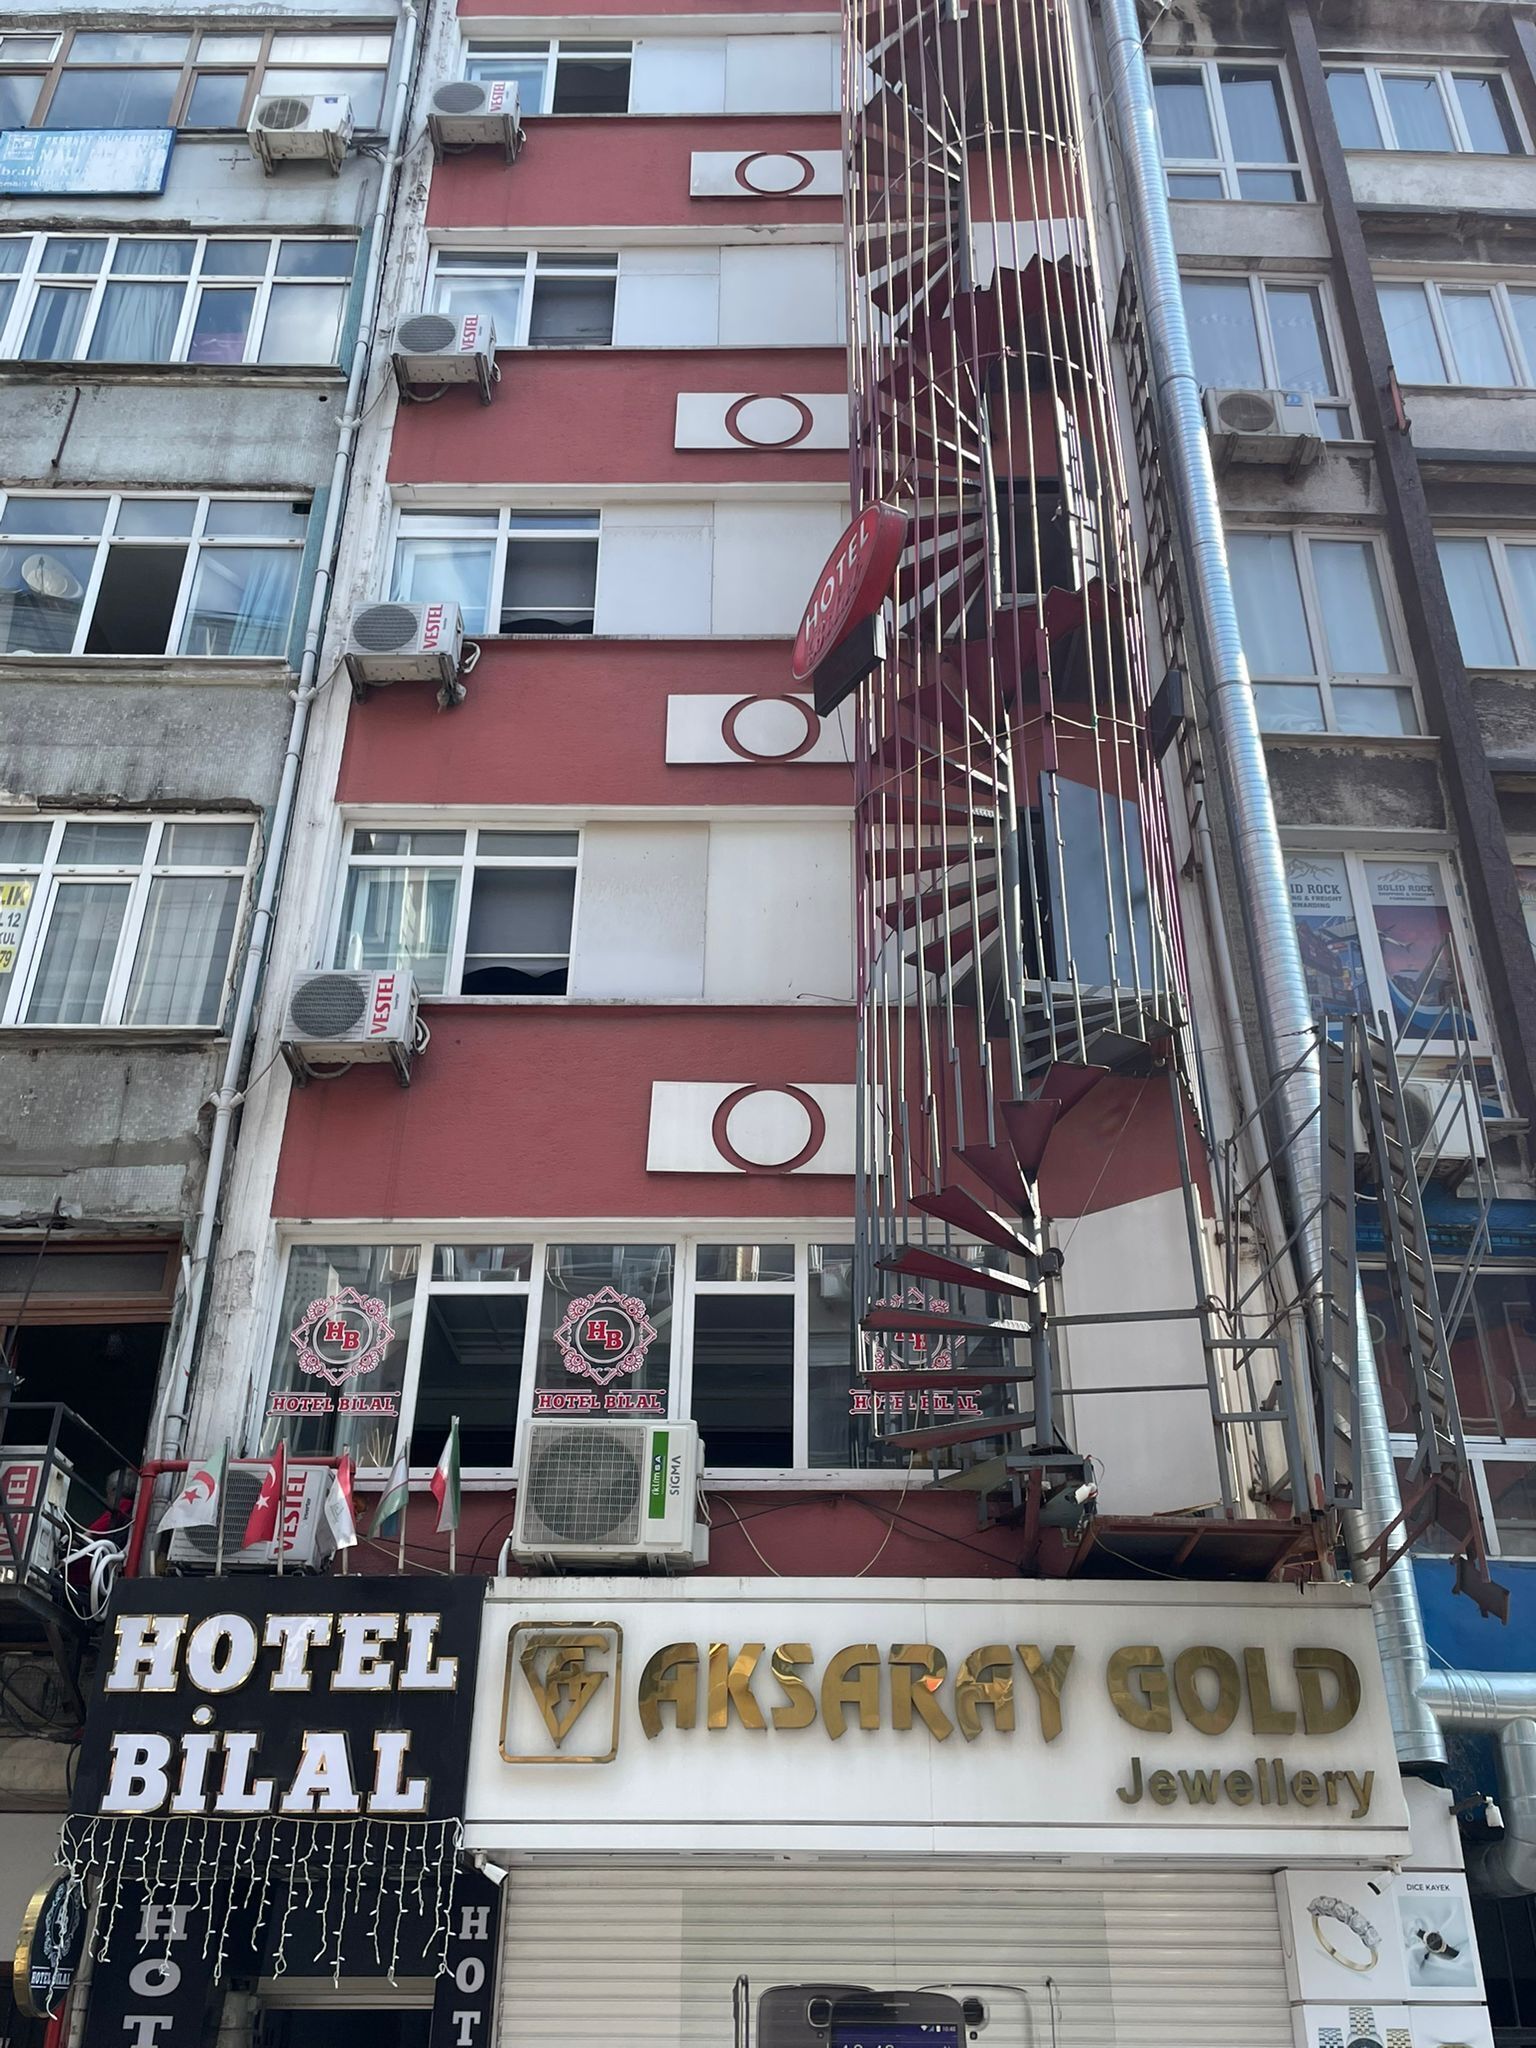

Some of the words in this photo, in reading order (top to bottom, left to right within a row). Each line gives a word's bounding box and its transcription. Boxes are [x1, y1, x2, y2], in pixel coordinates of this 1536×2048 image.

[490, 81, 506, 112] VESTEL
[461, 314, 478, 351] VESTEL
[805, 519, 869, 642] HOTEL
[423, 604, 443, 650] VESTEL
[1307, 884, 1341, 895] ROCK
[371, 973, 395, 1035] VESTEL
[272, 1397, 334, 1412] HOTEL
[337, 1395, 395, 1412] BİLAL
[538, 1394, 600, 1409] HOTEL
[604, 1391, 660, 1409] BİLAL
[274, 1471, 308, 1554] VESTEL
[104, 1612, 460, 1693] HOTEL
[638, 1642, 1076, 1744] AKSARAY
[1106, 1644, 1362, 1736] GOLD
[98, 1703, 431, 1814] BİLAL
[1116, 1756, 1375, 1819] Jewellery
[1406, 1883, 1424, 1891] DICE
[1425, 1883, 1450, 1891] KAYEK
